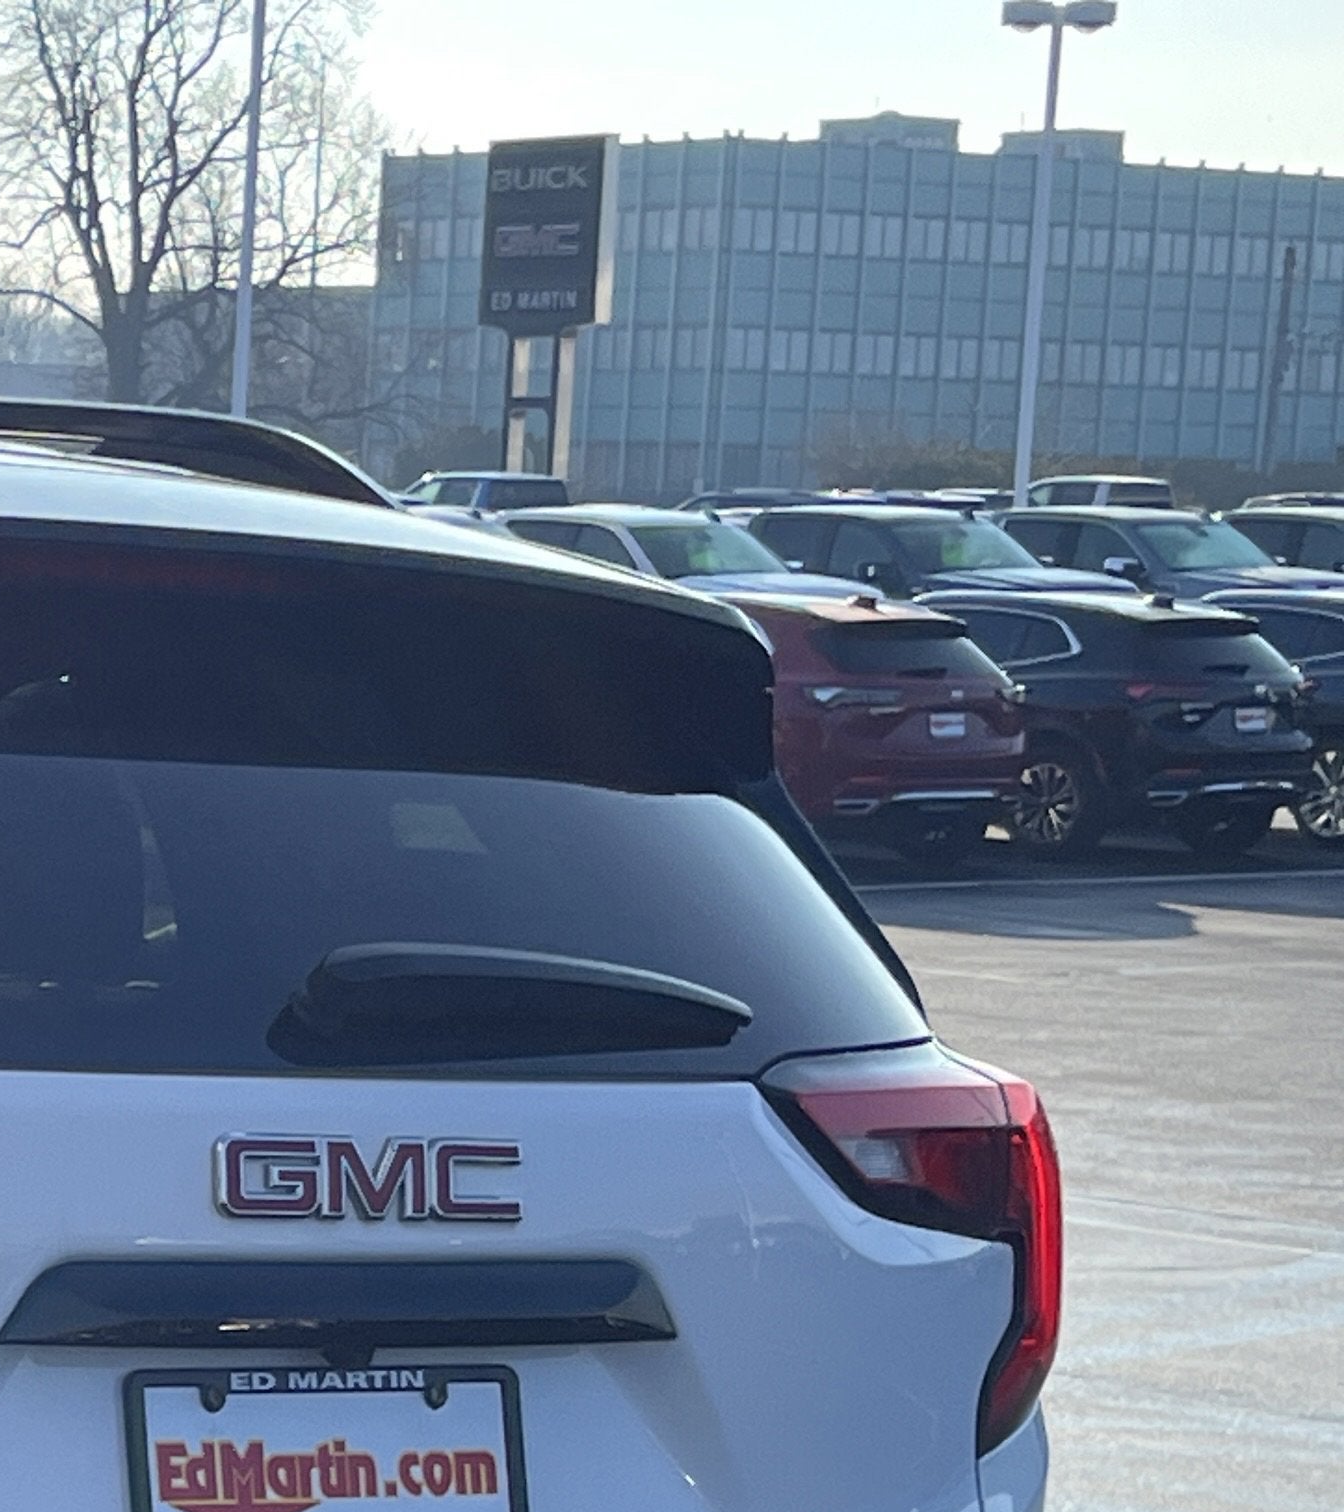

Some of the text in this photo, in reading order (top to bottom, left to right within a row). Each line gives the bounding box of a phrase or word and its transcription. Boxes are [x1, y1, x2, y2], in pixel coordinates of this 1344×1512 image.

[491, 165, 588, 193] BUICK
[494, 224, 581, 258] GMC
[490, 289, 577, 311] ED MARTIN
[215, 1132, 522, 1222] GMC
[230, 1370, 425, 1391] ED MARTIN
[155, 1439, 499, 1502] EdMartin.com
